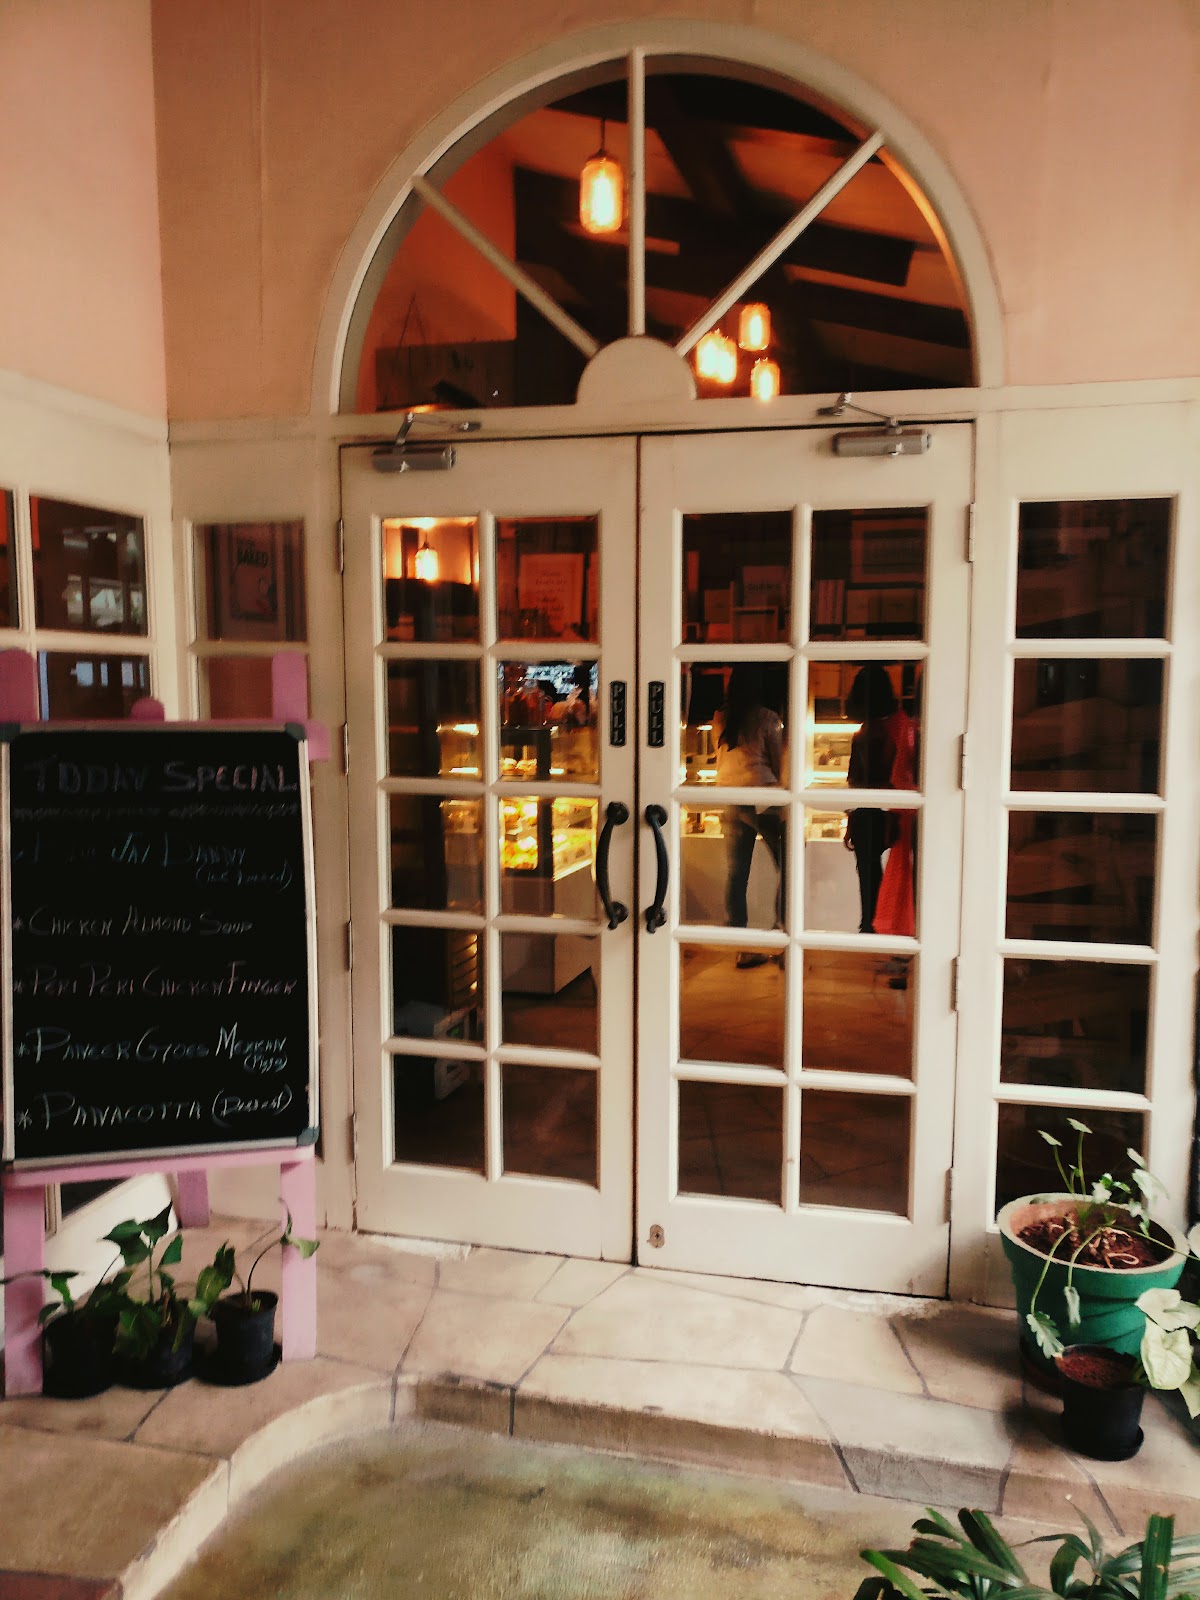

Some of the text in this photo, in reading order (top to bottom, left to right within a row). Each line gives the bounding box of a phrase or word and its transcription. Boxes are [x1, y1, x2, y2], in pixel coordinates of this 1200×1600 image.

[613, 684, 623, 744] PULL
[651, 684, 662, 744] PULL
[24, 756, 298, 793] TODAY SPECIAL
[29, 904, 112, 936] CHICKEN
[122, 904, 192, 936] ALMOND
